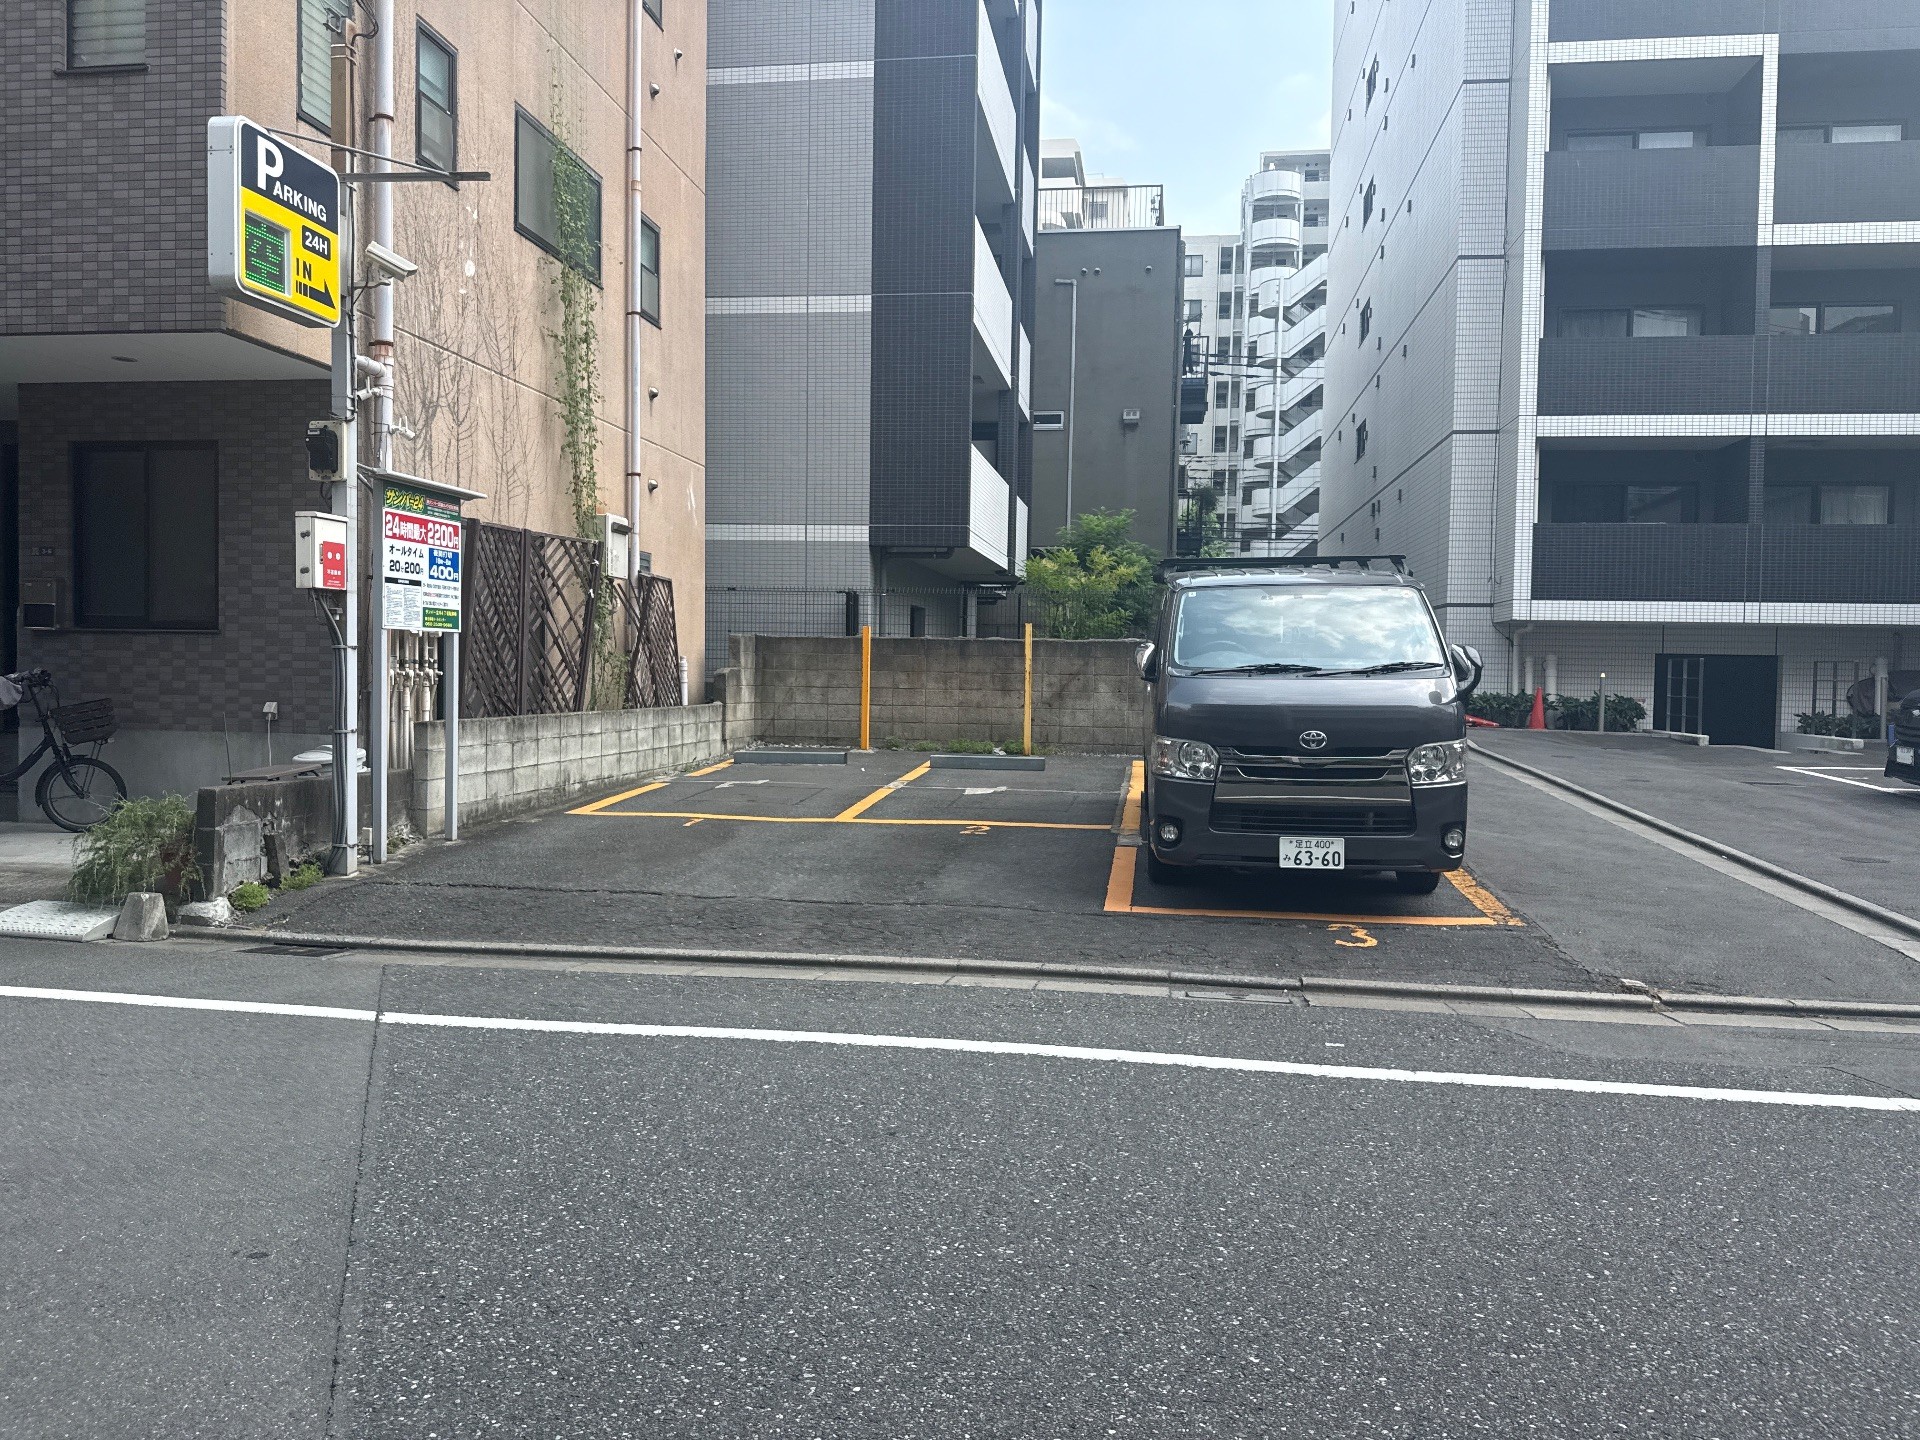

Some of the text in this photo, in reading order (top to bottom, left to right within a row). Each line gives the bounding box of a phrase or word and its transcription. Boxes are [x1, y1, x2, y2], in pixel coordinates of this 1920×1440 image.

[257, 135, 327, 222] PARKING
[304, 231, 328, 256] 24H
[295, 257, 312, 282] IN
[389, 543, 424, 559] オールタイム
[430, 564, 459, 581] 400円
[1295, 840, 1331, 849] 足立 400
[1294, 850, 1341, 867] 63-60
[1326, 923, 1378, 948] 3
